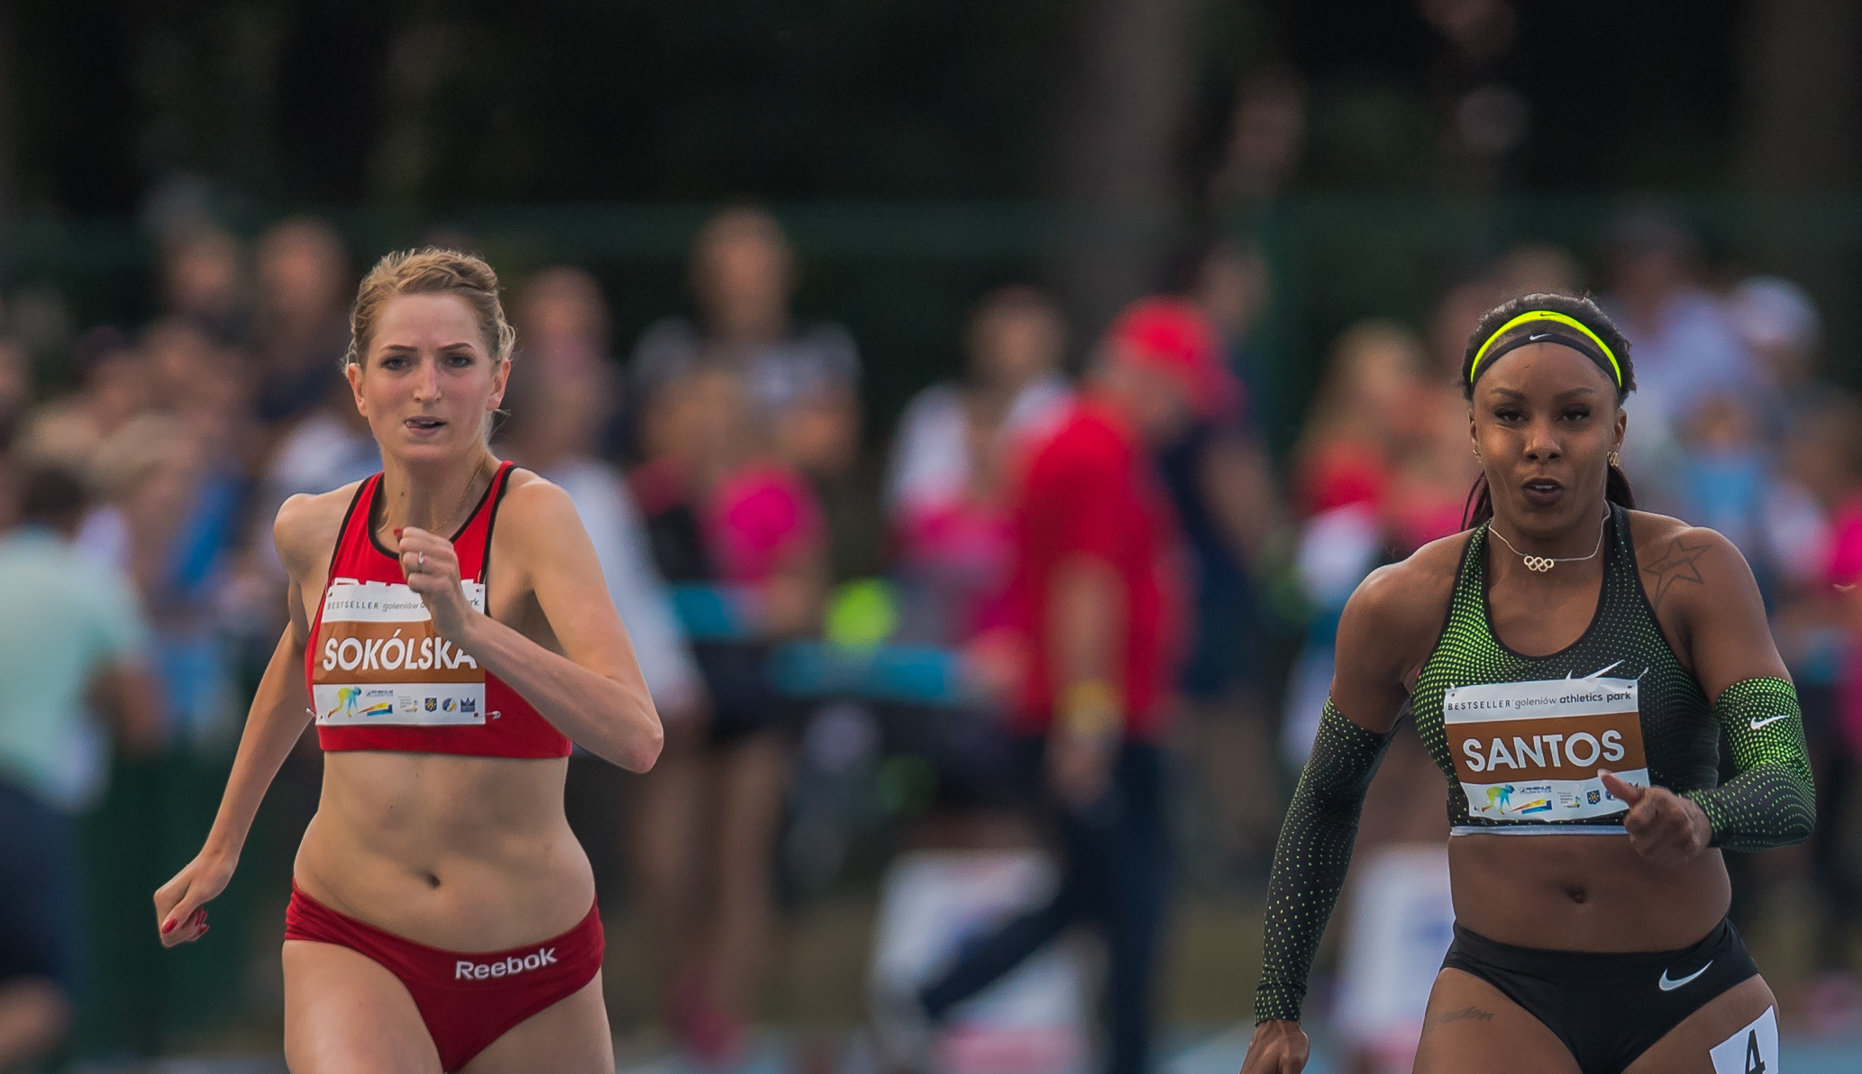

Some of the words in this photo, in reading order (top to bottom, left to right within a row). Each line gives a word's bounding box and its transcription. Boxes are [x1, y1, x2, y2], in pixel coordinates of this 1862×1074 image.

[327, 601, 379, 610] BESTSELLER
[1447, 700, 1511, 711] BESTSELLER
[1514, 696, 1557, 709] goleniów
[1559, 692, 1604, 704] athletics
[1606, 691, 1631, 703] park
[1462, 729, 1625, 772] SANTOS
[455, 947, 558, 980] Reebok
